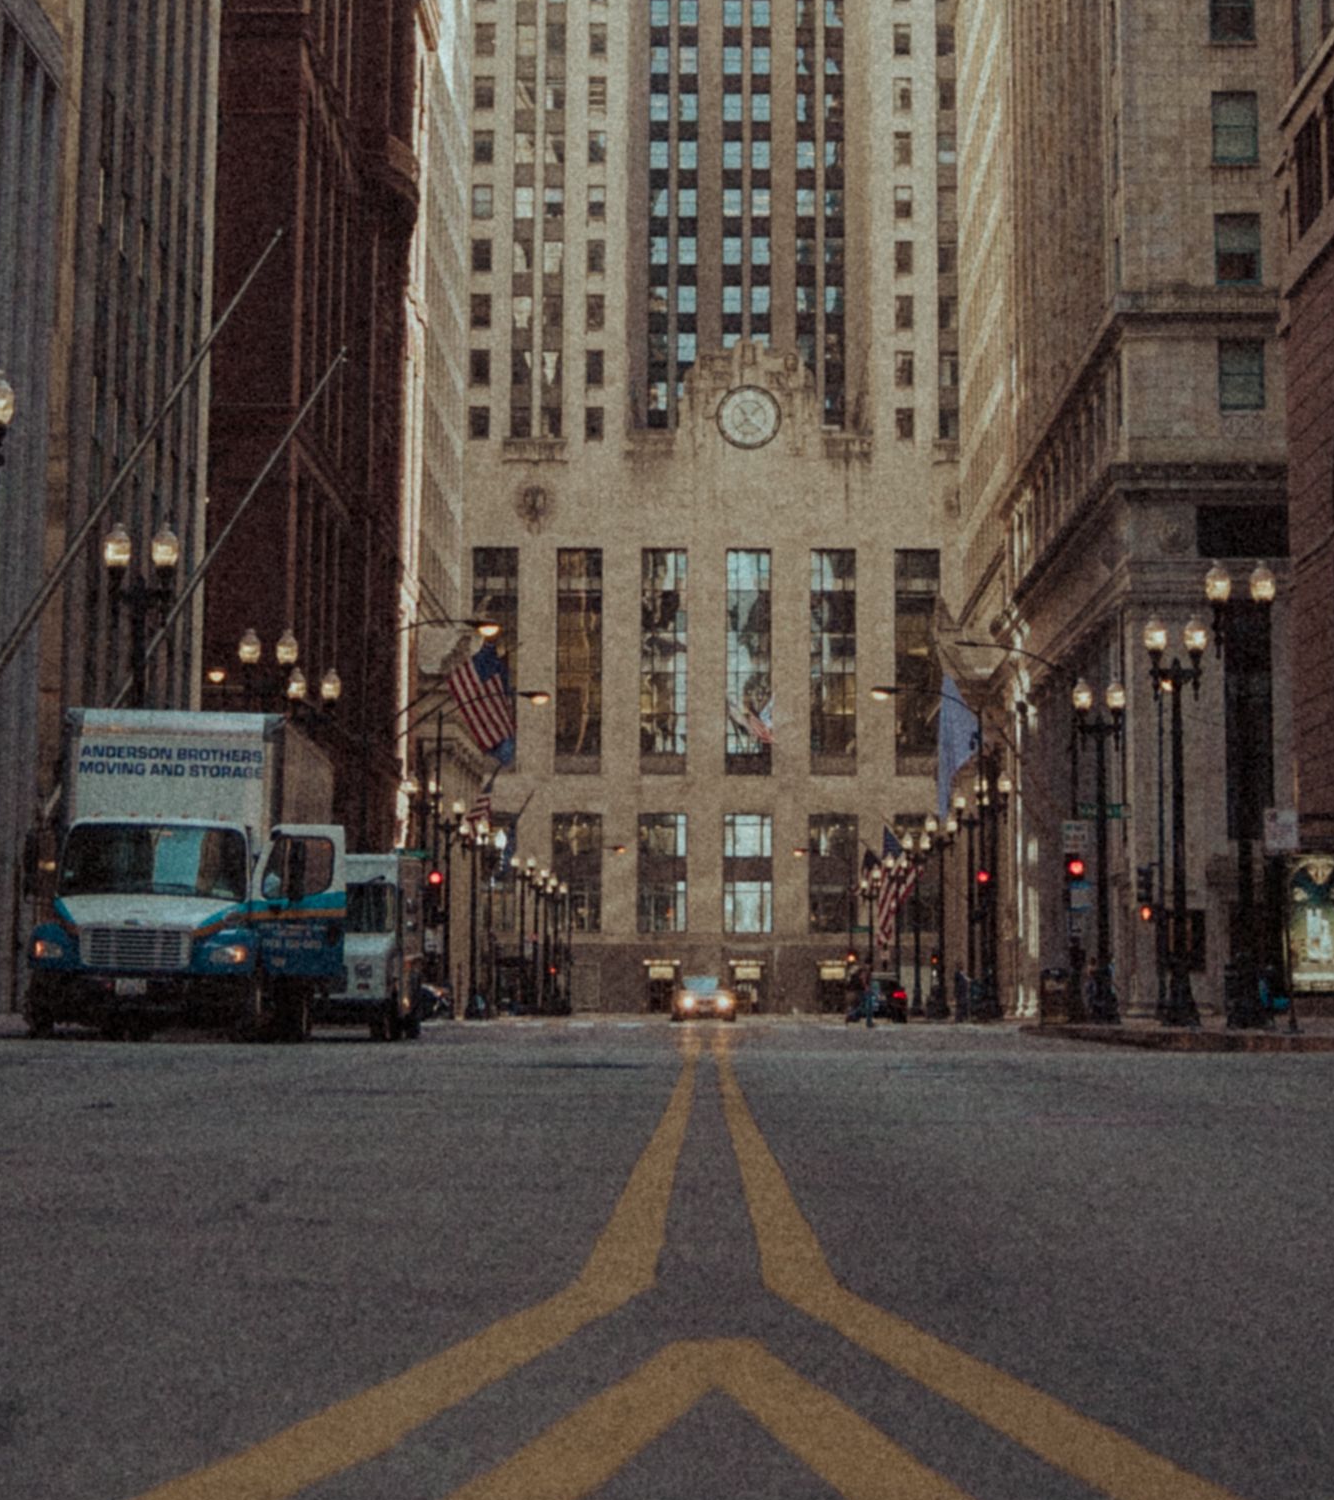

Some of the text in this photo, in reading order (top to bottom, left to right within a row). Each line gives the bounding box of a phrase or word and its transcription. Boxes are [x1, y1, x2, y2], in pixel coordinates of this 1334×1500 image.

[81, 745, 263, 764] ANDERSON BROTHERS
[79, 761, 264, 780] MOVING AND STORAGE
